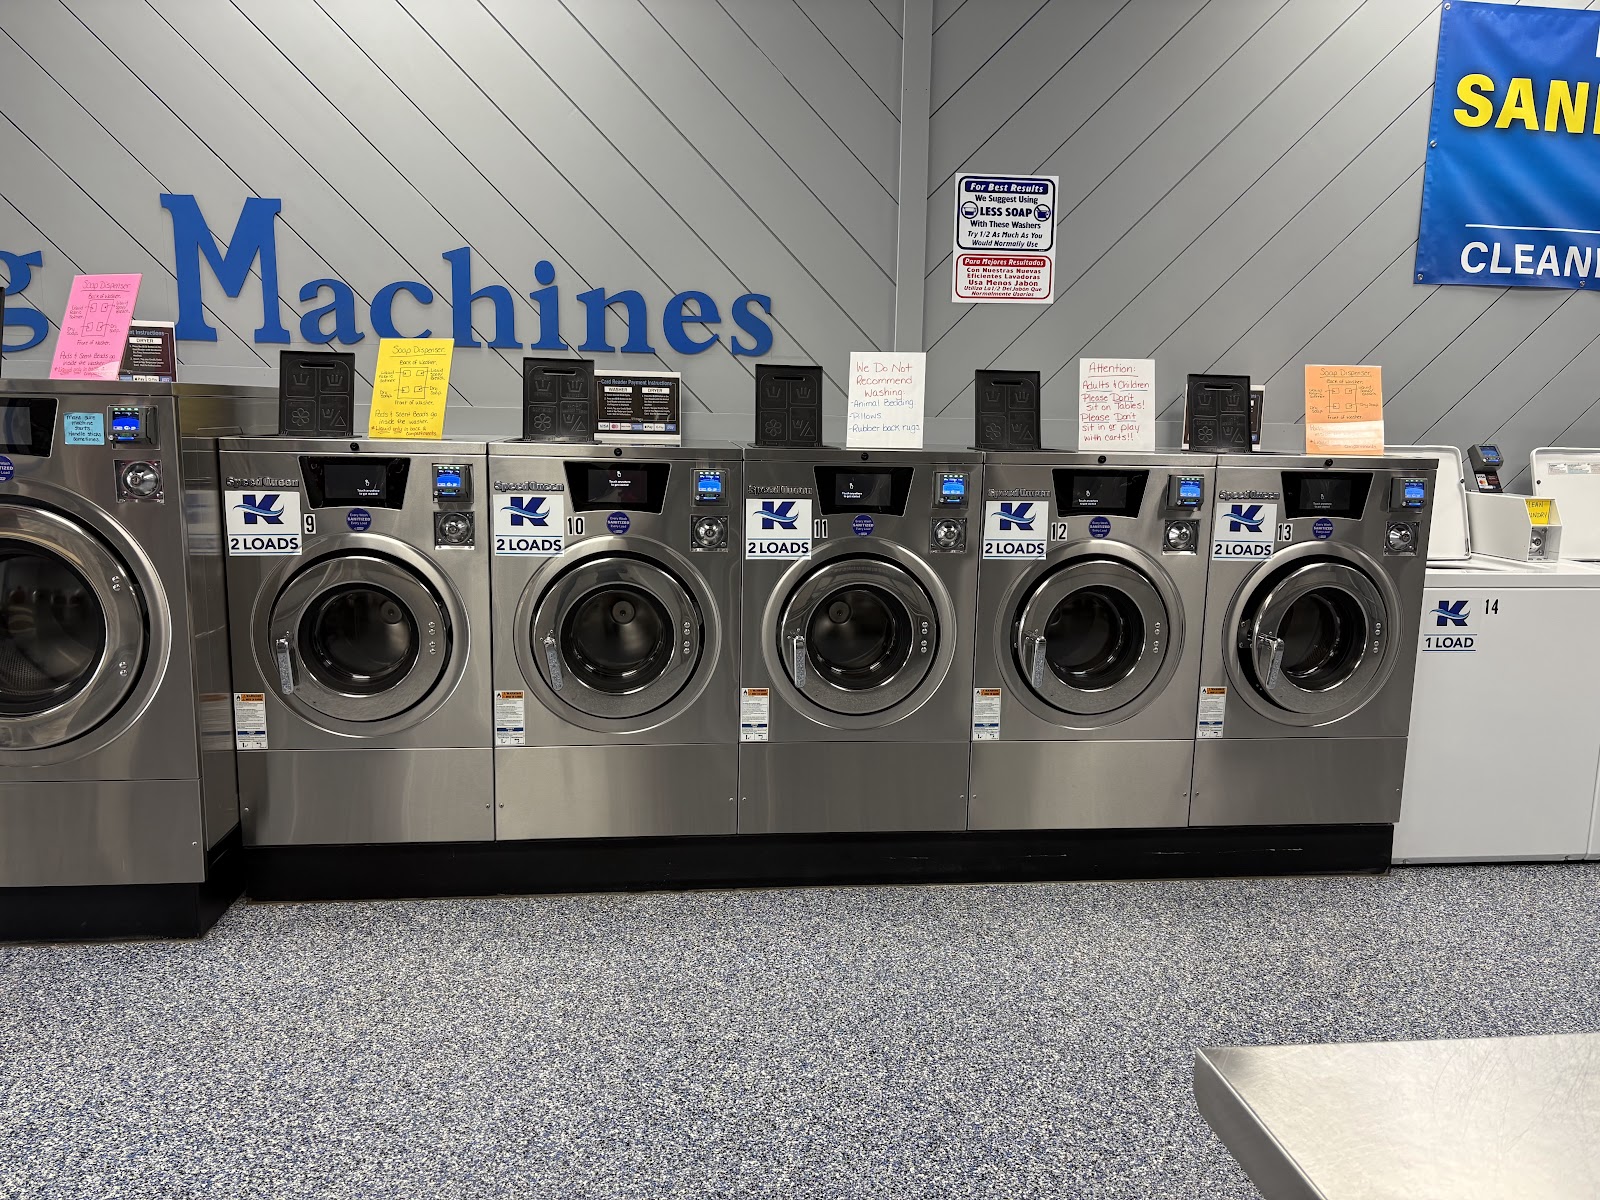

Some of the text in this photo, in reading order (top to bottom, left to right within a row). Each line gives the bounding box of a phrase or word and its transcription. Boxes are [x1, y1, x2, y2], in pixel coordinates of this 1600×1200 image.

[970, 183, 1044, 193] For Best Results
[975, 194, 1038, 205] We Suggest Using
[980, 207, 1032, 217] LESS SOAP
[970, 220, 987, 228] With
[1011, 221, 1041, 229] Washers
[994, 240, 1025, 248] Normally
[1460, 241, 1600, 278] CLEAN
[160, 192, 774, 356] Machines
[83, 280, 99, 289] Soap
[392, 345, 411, 355] Soap
[856, 362, 912, 373] We Do Not
[856, 375, 912, 385] Recommend
[1083, 381, 1110, 389] Adults
[1118, 380, 1149, 389] Children
[1081, 393, 1134, 402] Please Don't
[884, 399, 914, 409] Bedding
[1080, 412, 1136, 422] Please Don't
[903, 424, 920, 434] rugs
[1121, 424, 1139, 433] play
[226, 476, 299, 488] Speed Queen
[494, 481, 564, 492] Speed Queen
[1219, 490, 1280, 501] Speed Queen
[242, 494, 284, 524] K
[510, 497, 550, 526] K
[762, 501, 799, 529] K
[1000, 503, 1036, 530] K
[1229, 505, 1265, 532] K
[306, 515, 315, 532] 9
[567, 518, 583, 534] 10
[815, 520, 827, 538] 11
[1051, 524, 1066, 540] 12
[1278, 525, 1291, 540] 13
[231, 538, 298, 550] 2 LOADS
[497, 539, 562, 551] 2 LOADS
[748, 542, 809, 553] 2 LOADS
[985, 543, 1044, 554] 2 LOADS
[1215, 544, 1271, 555] 2 LOADS
[1484, 599, 1498, 615] 14
[1425, 637, 1474, 649] 1 LOAD
